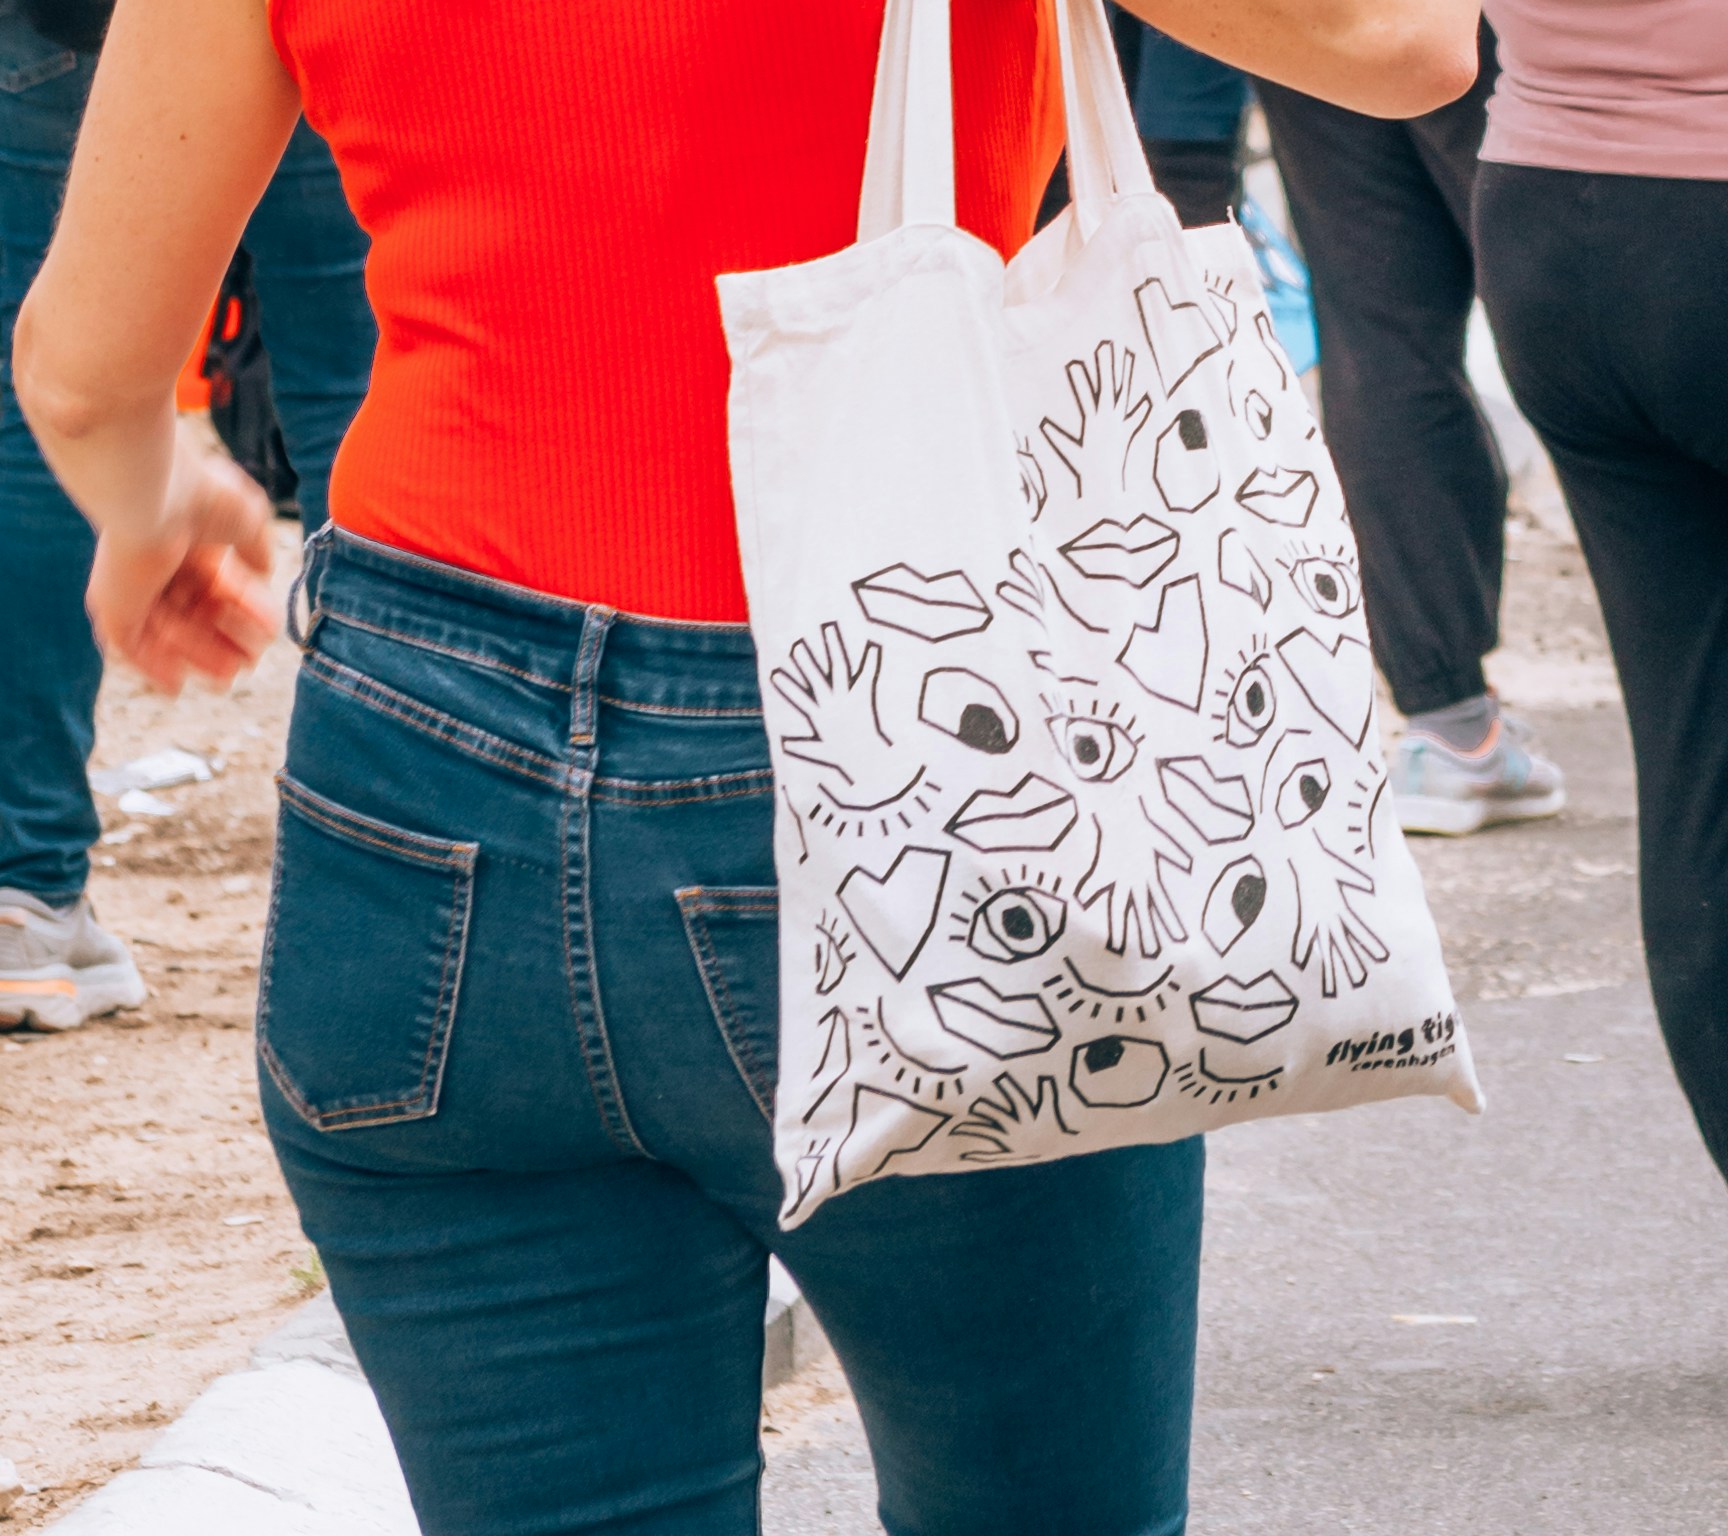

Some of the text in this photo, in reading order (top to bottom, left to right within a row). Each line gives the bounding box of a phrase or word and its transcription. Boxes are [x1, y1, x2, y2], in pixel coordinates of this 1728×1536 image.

[1326, 1011, 1458, 1067] flying tig
[1351, 1043, 1455, 1071] copenhagen
